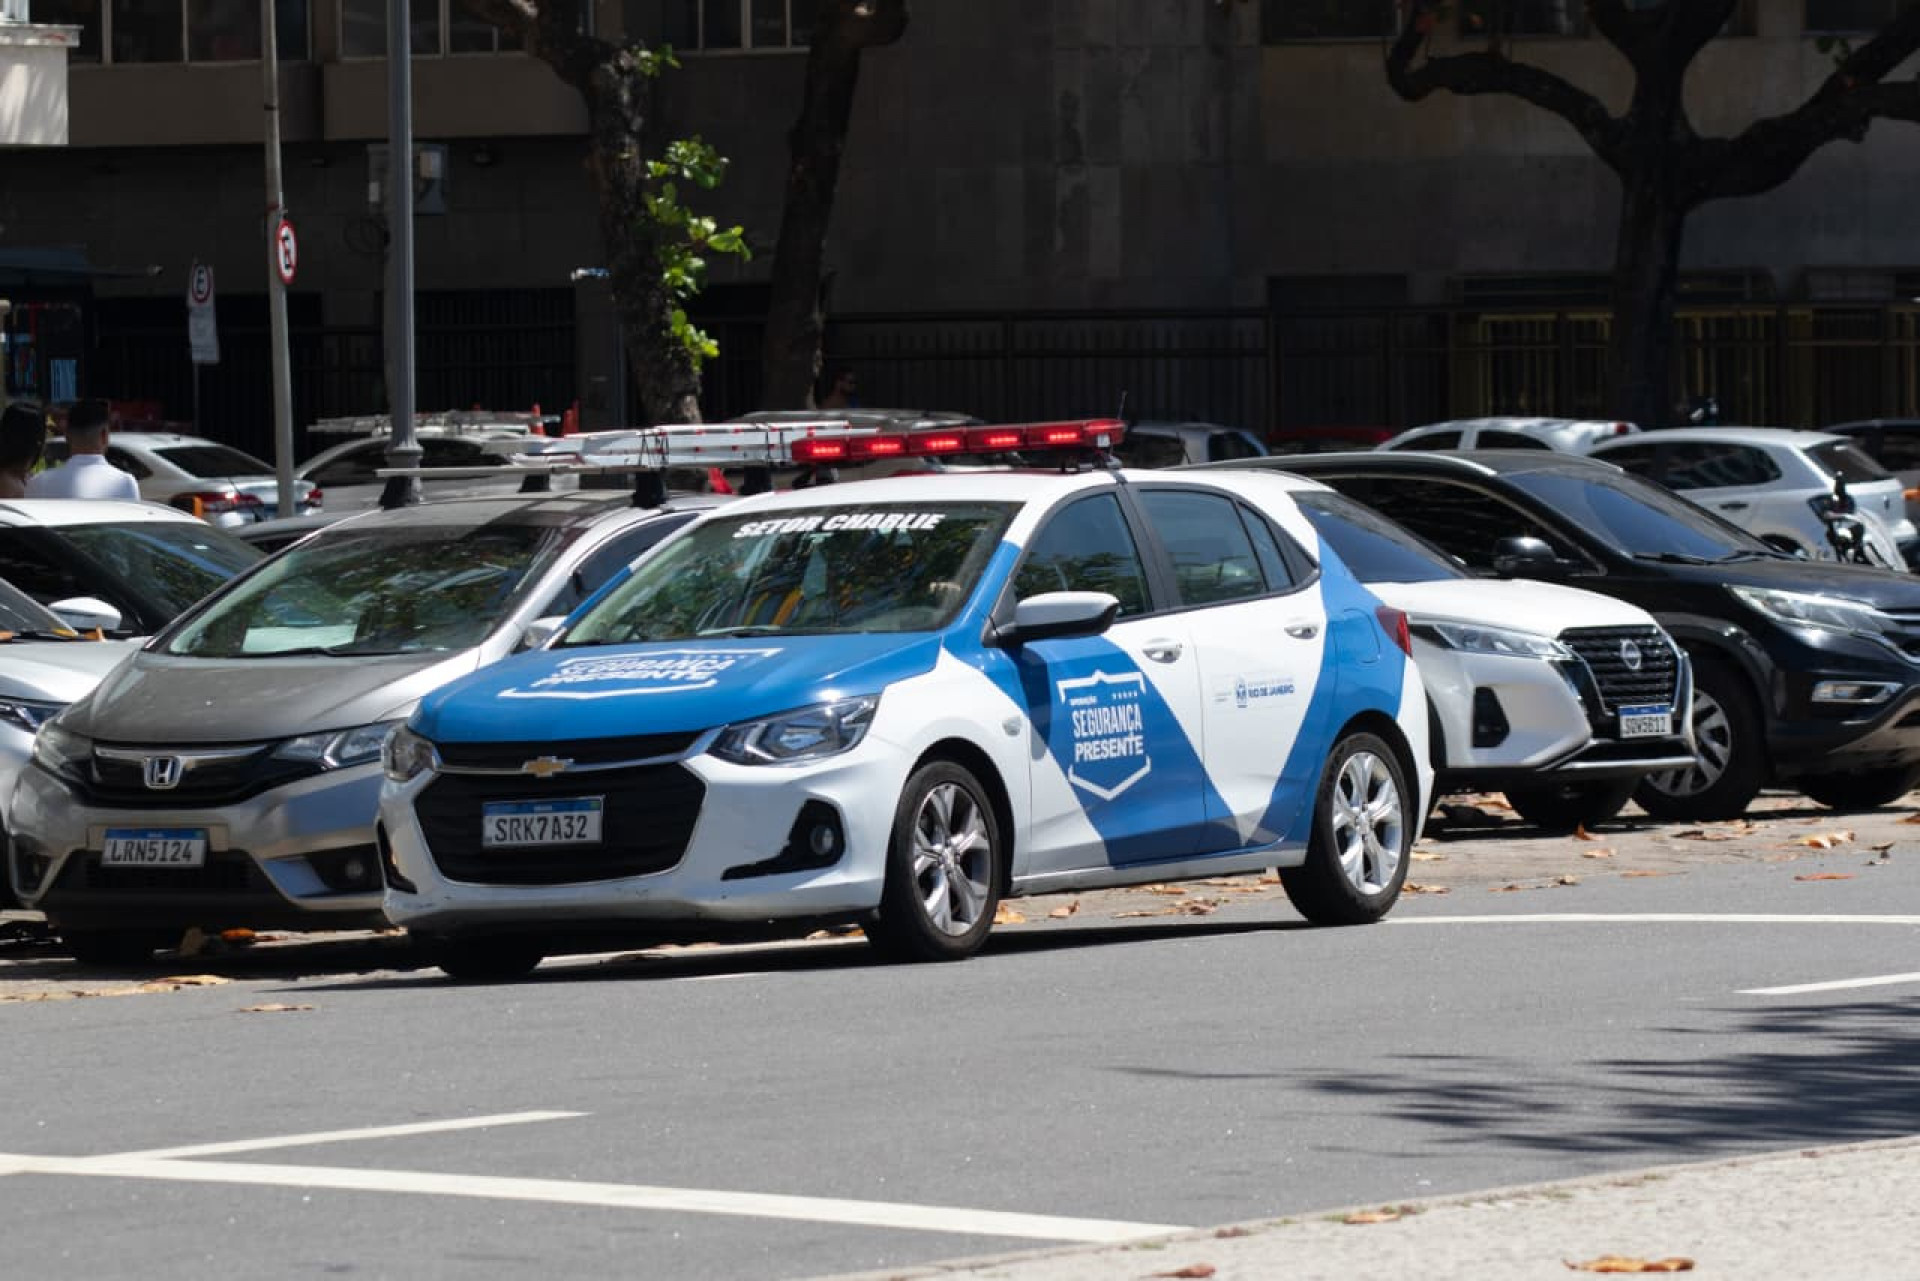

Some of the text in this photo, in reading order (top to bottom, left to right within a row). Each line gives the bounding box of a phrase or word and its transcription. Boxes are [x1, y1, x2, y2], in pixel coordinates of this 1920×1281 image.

[732, 512, 946, 538] SETOR CHARLIE
[1072, 703, 1143, 739] SEGURANÇA
[1075, 734, 1144, 762] PRESENTE
[494, 815, 588, 842] SRK7A32
[110, 840, 193, 862] LRN5I24
